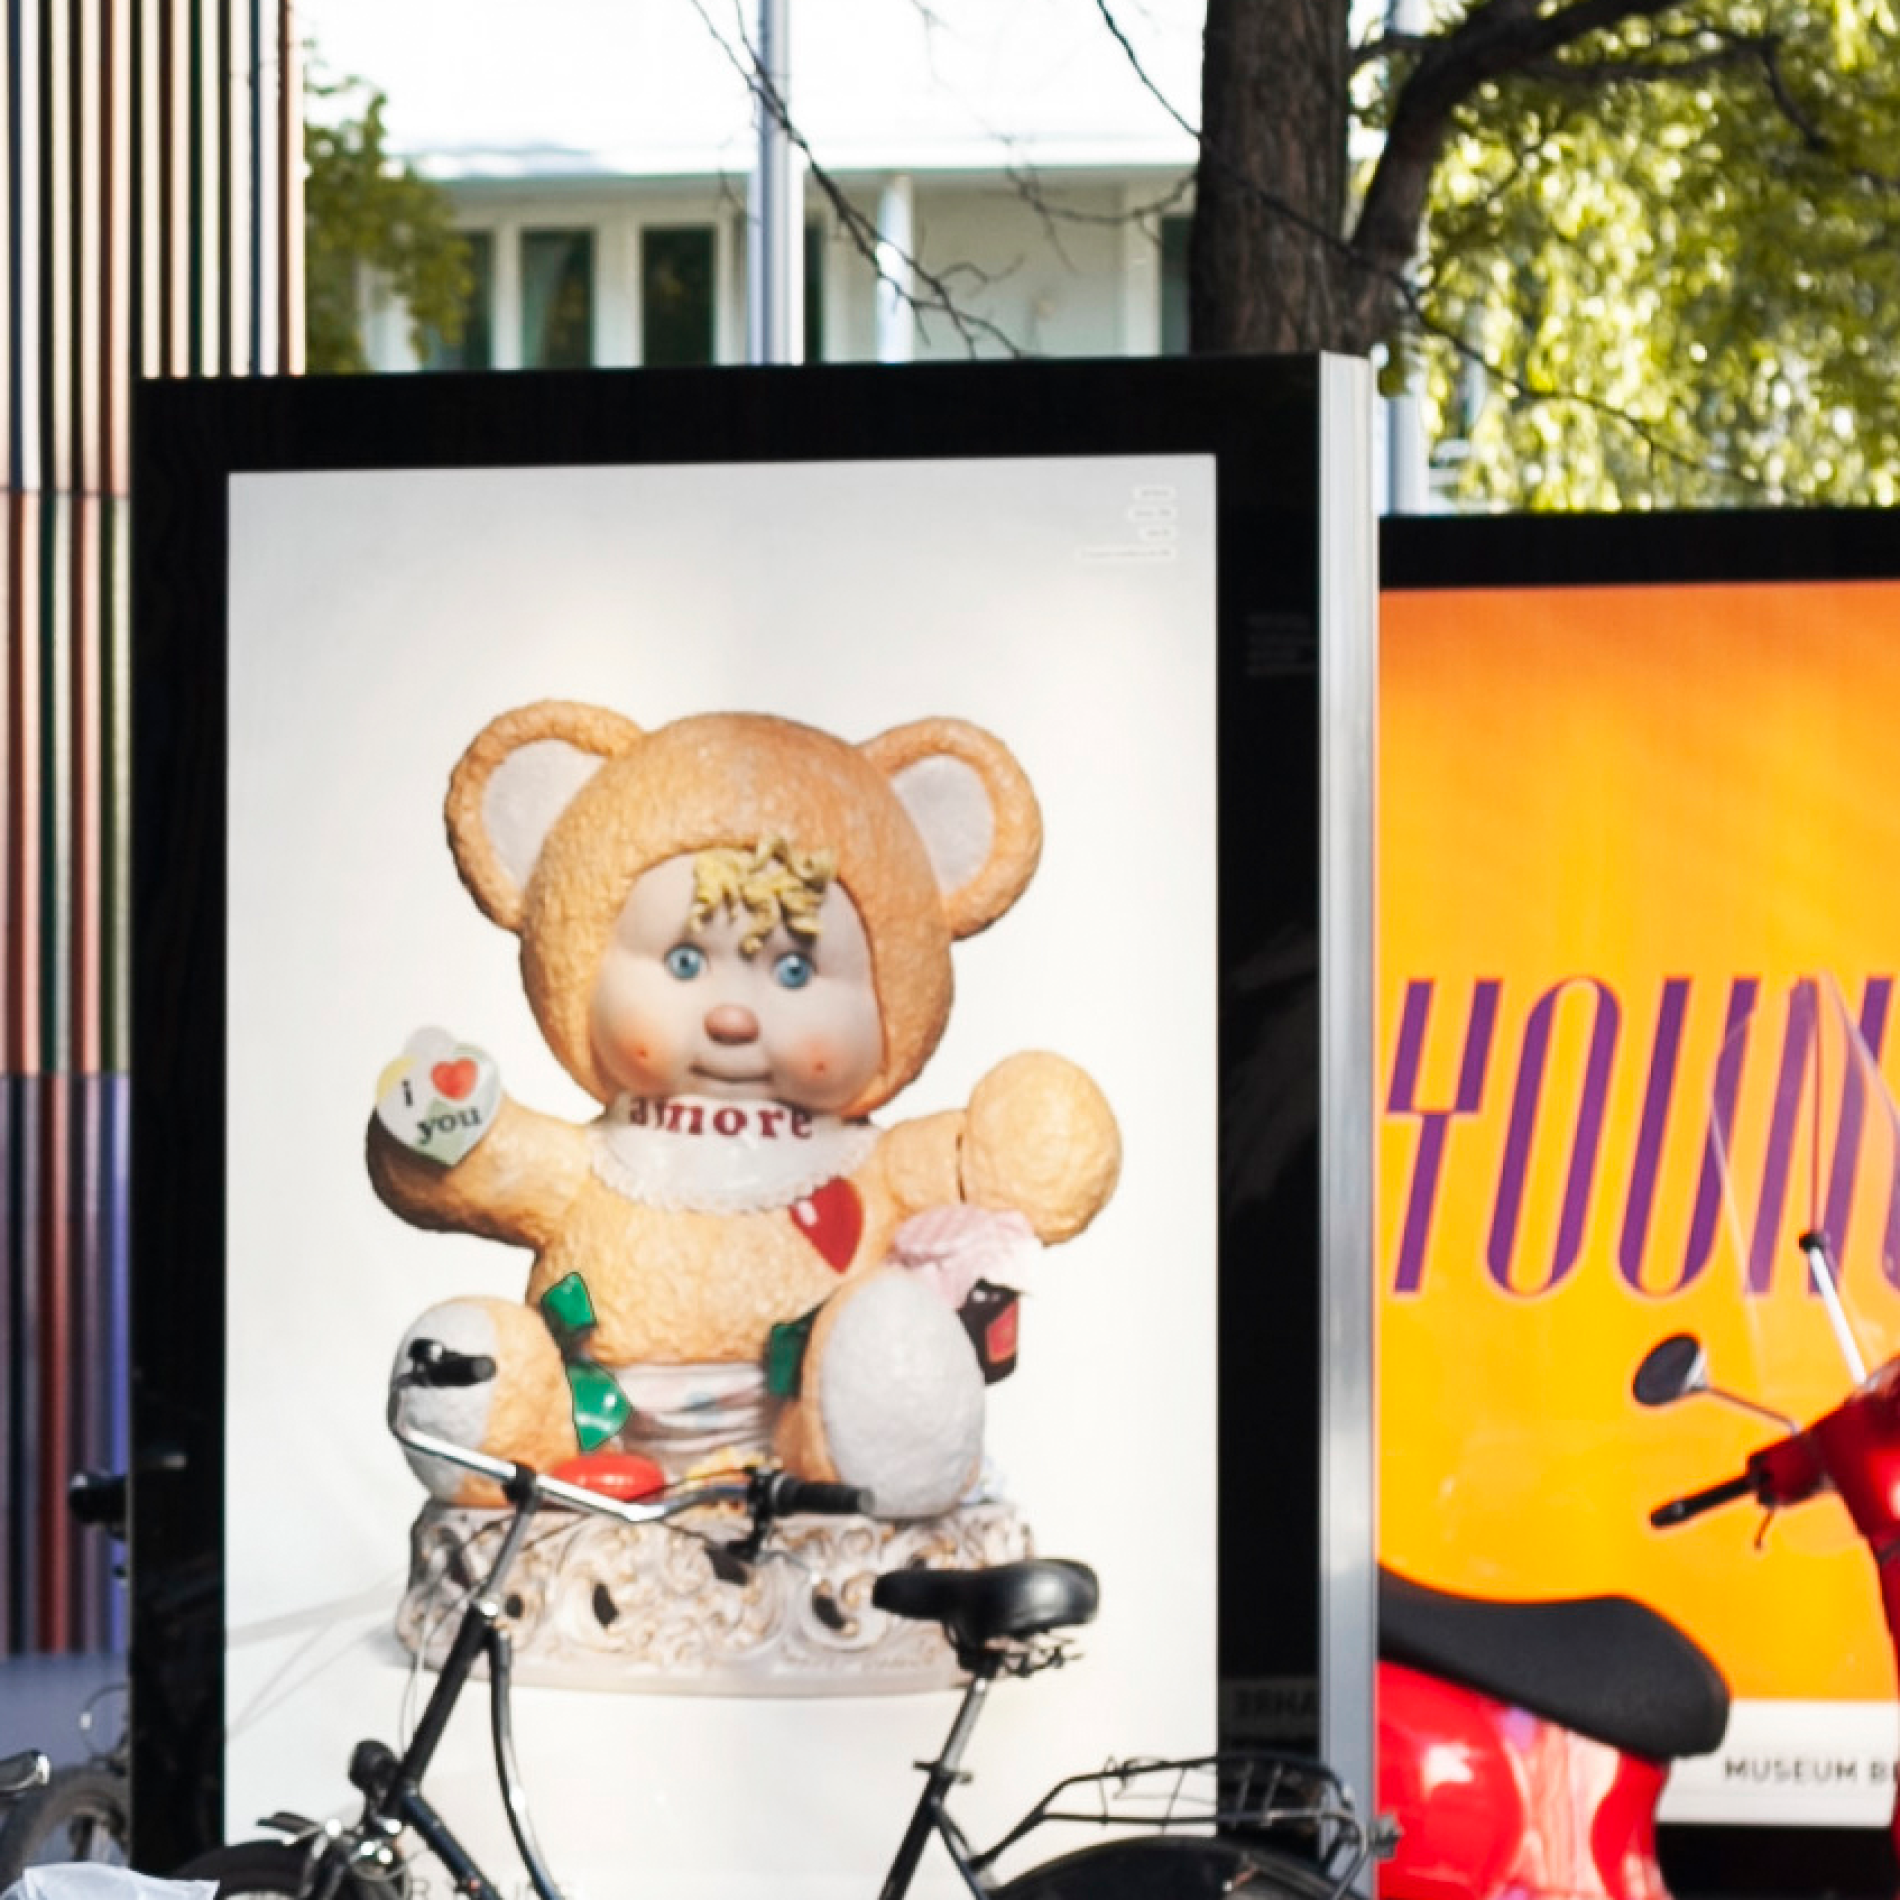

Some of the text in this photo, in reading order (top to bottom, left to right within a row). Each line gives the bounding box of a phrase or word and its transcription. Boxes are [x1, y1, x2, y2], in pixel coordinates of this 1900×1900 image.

[416, 1107, 481, 1145] you
[628, 1097, 812, 1139] amore
[1385, 974, 1900, 1298] YOUN
[1725, 1757, 1857, 1782] MUSEUM
